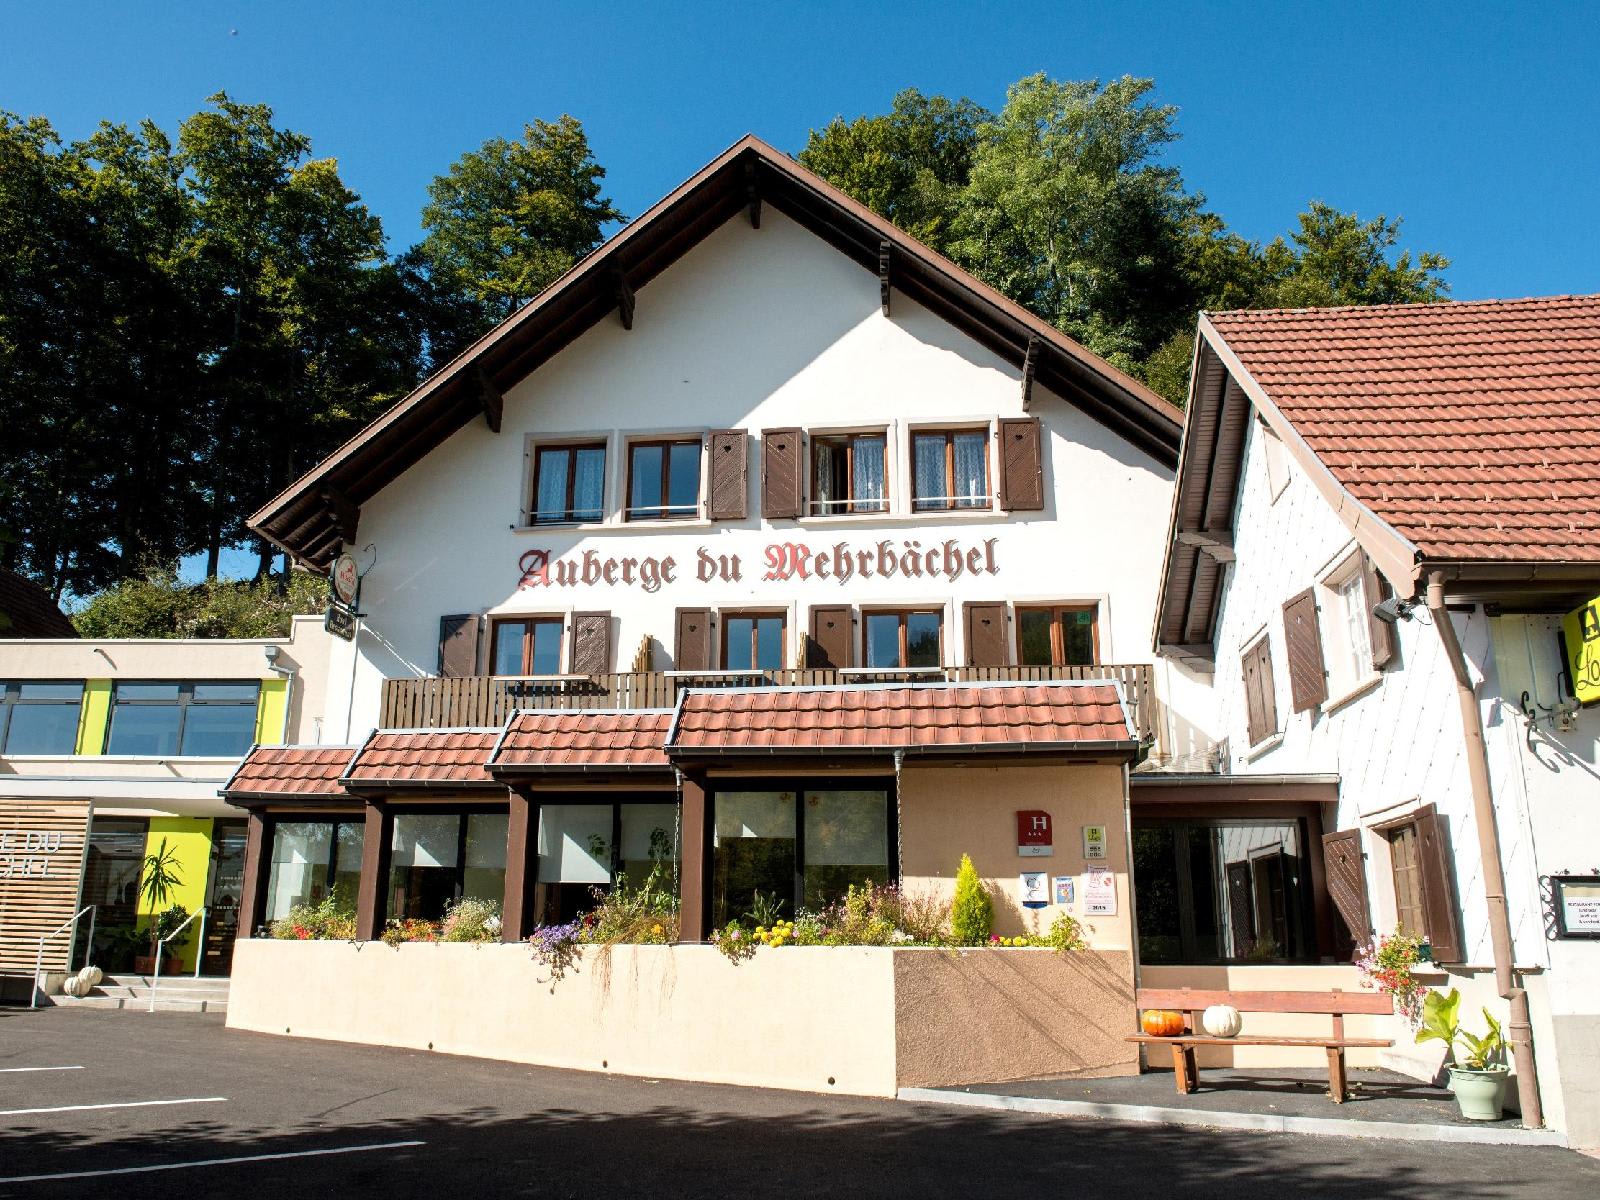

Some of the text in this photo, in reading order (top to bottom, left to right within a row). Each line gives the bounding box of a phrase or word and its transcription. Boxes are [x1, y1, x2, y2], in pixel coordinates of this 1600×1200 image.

[518, 538, 1000, 593] Auberge du Mehrbächel
[1032, 816, 1047, 830] H
[25, 831, 62, 853] DU
